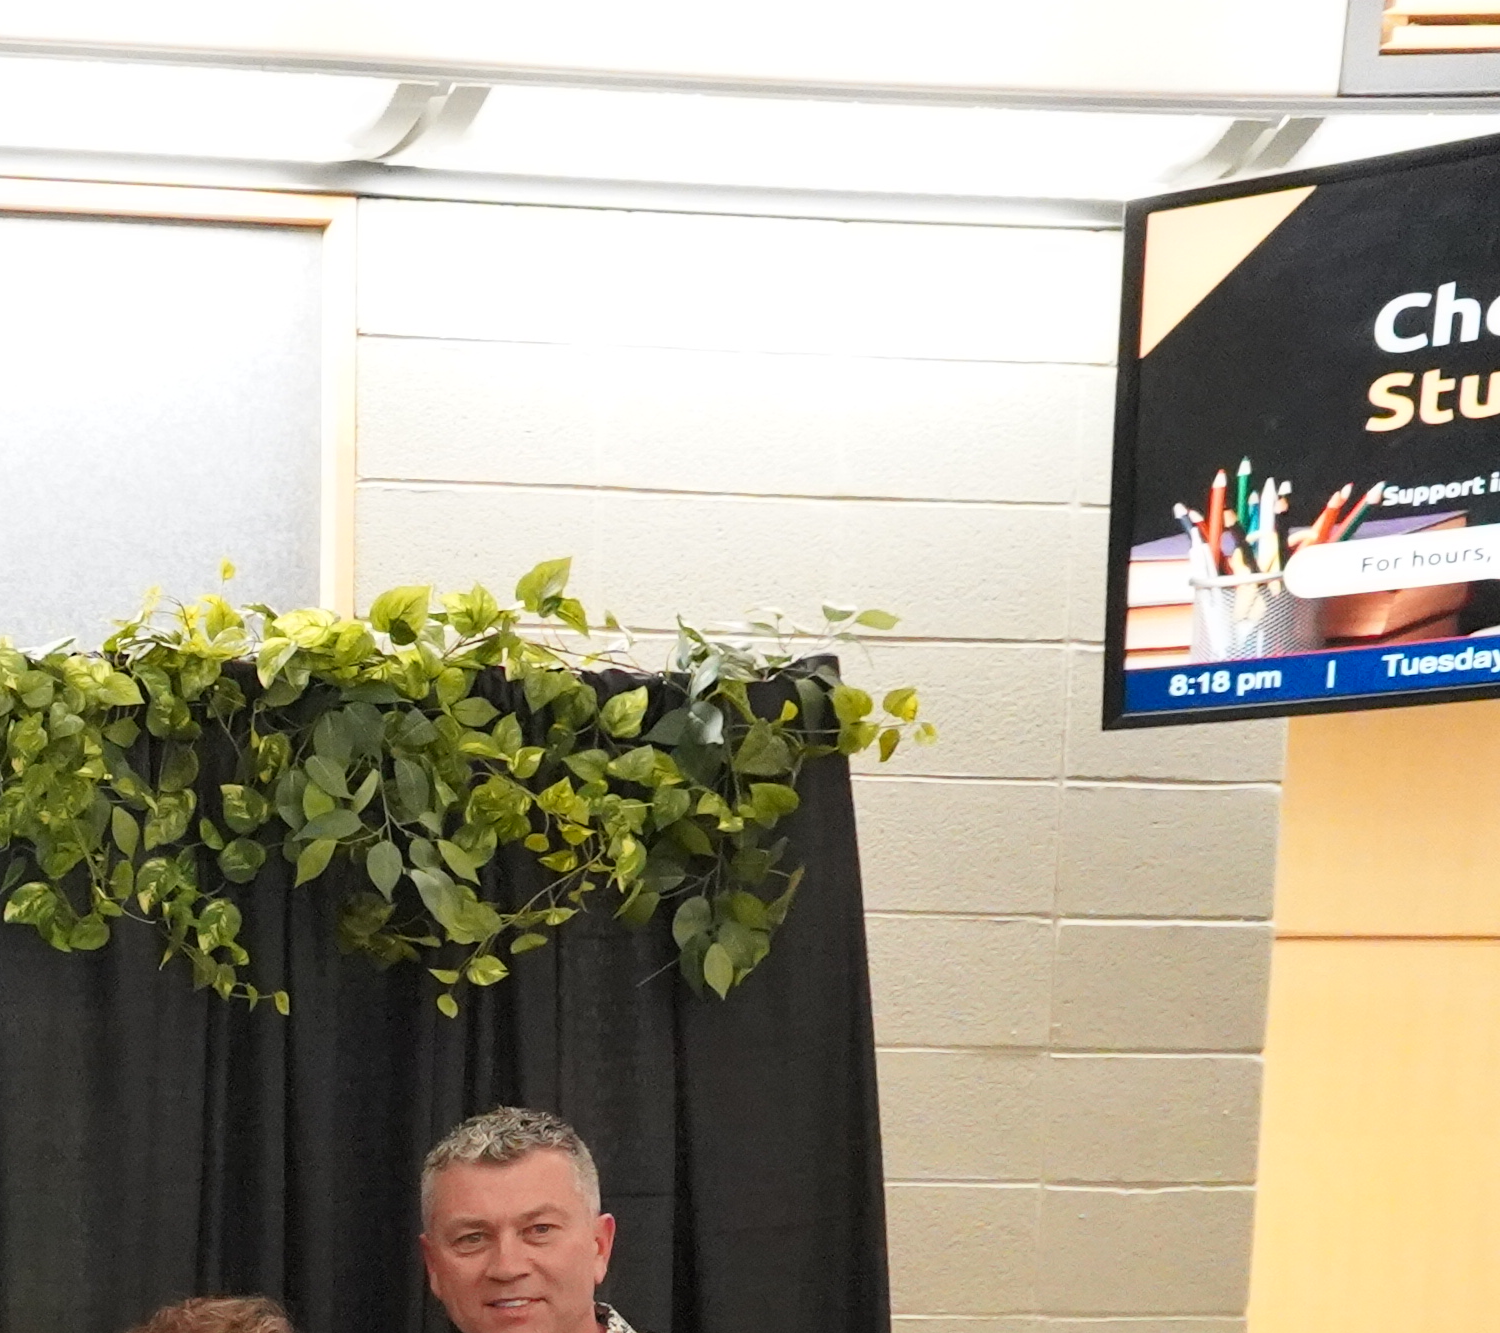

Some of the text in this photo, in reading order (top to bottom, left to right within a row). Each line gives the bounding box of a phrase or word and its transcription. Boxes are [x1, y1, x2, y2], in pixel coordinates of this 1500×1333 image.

[1374, 281, 1500, 353] Ch
[1382, 476, 1486, 507] Support
[1361, 546, 1492, 574] For hours,
[1168, 669, 1230, 698] 8:18
[1236, 668, 1282, 699] pm
